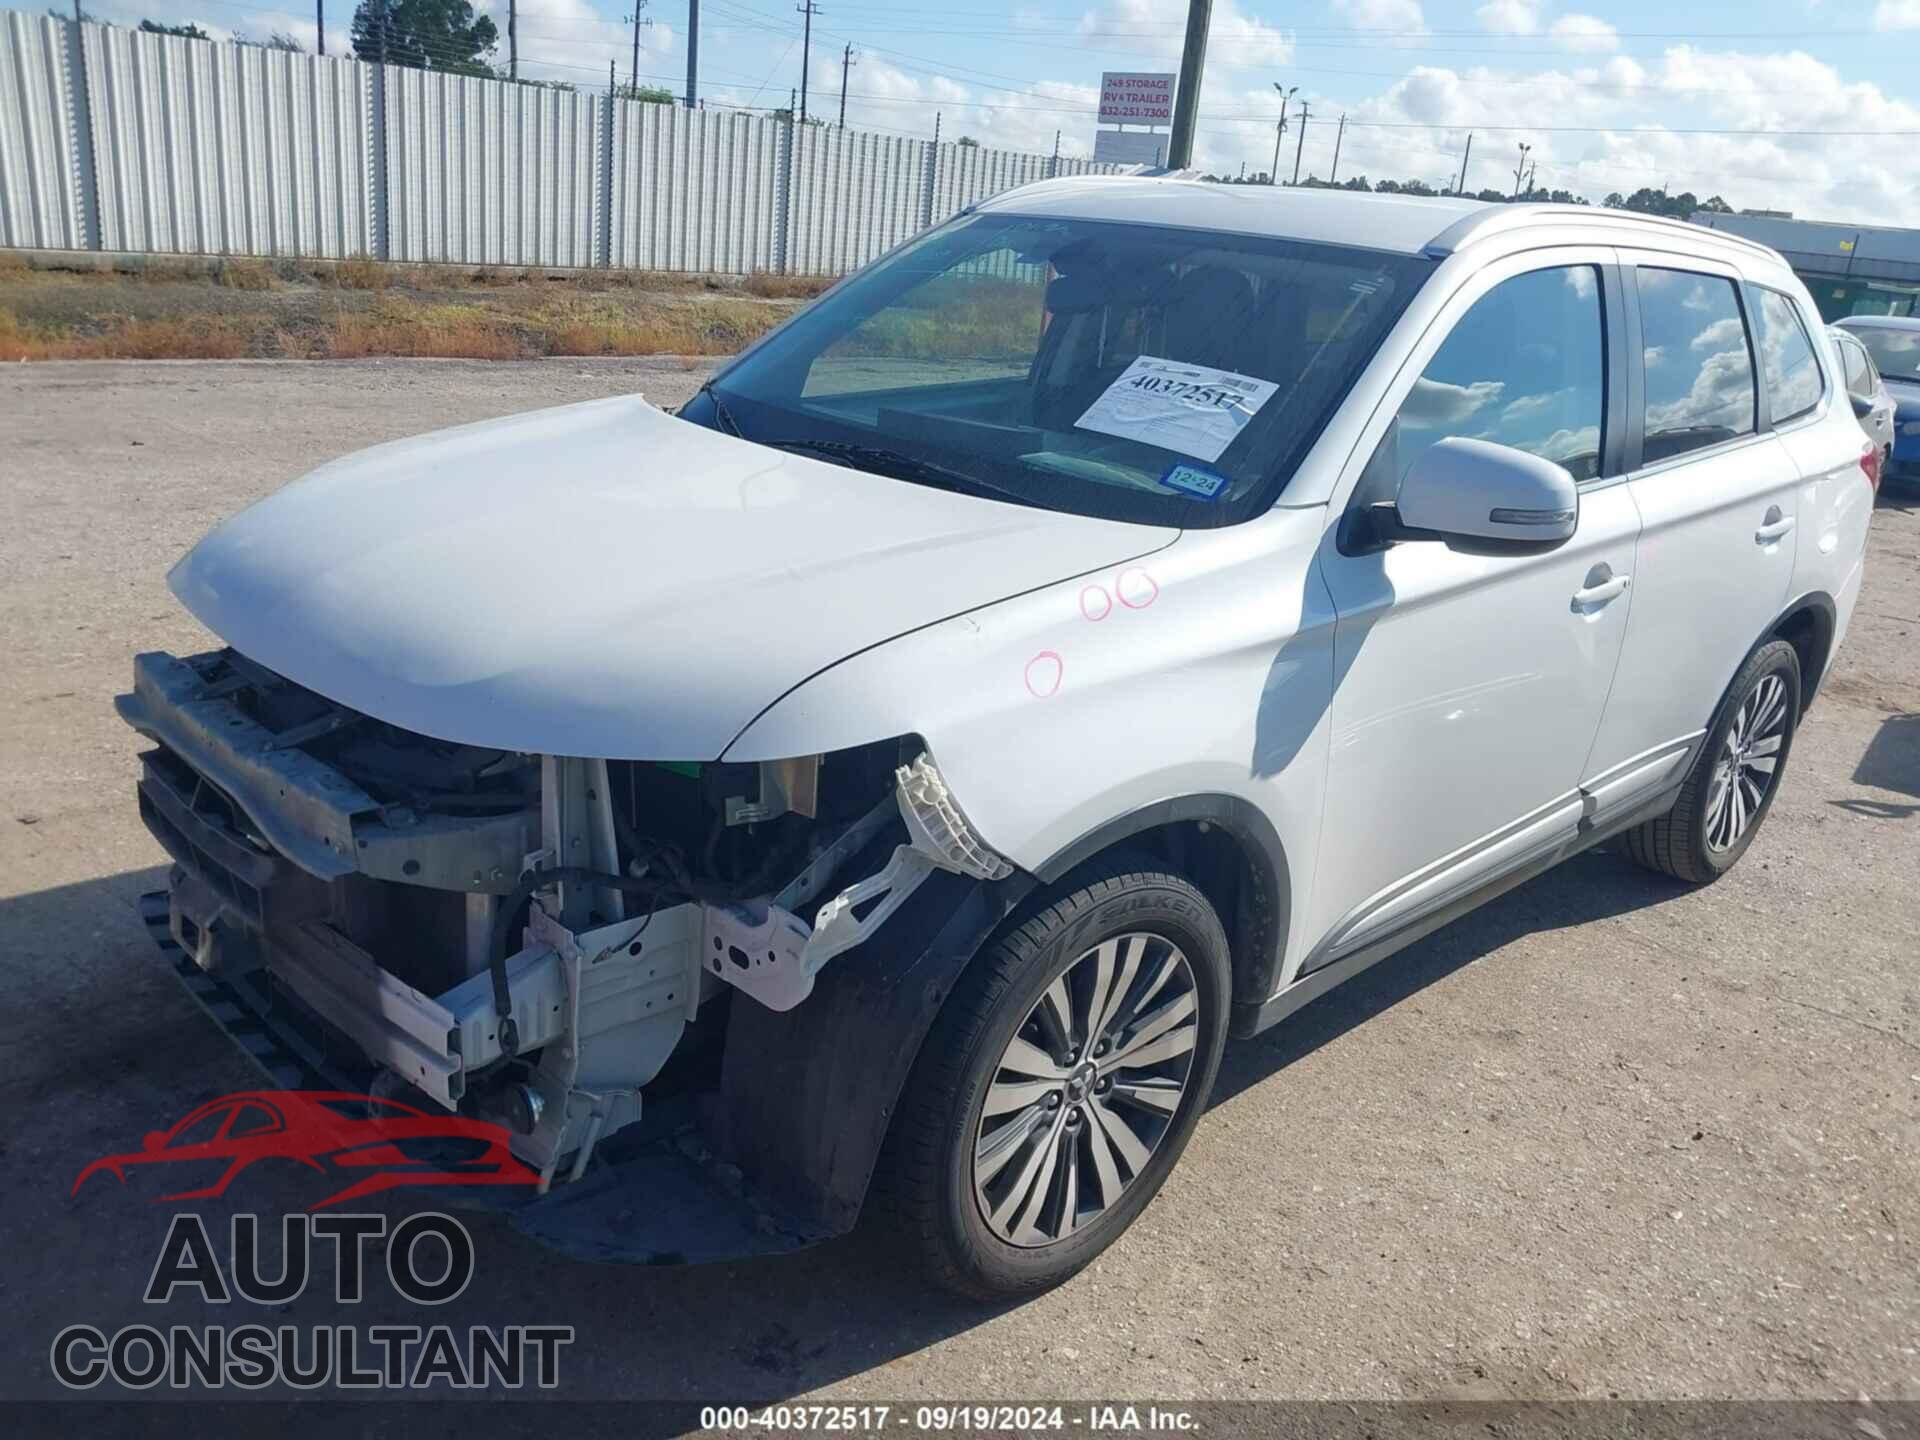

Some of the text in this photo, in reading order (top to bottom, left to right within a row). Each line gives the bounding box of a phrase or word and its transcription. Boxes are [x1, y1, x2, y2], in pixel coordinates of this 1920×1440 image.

[1126, 79, 1169, 89] STORAGE
[1103, 93, 1118, 102] RV
[1126, 93, 1169, 104] TRAILER
[1131, 375, 1244, 410] 40372517
